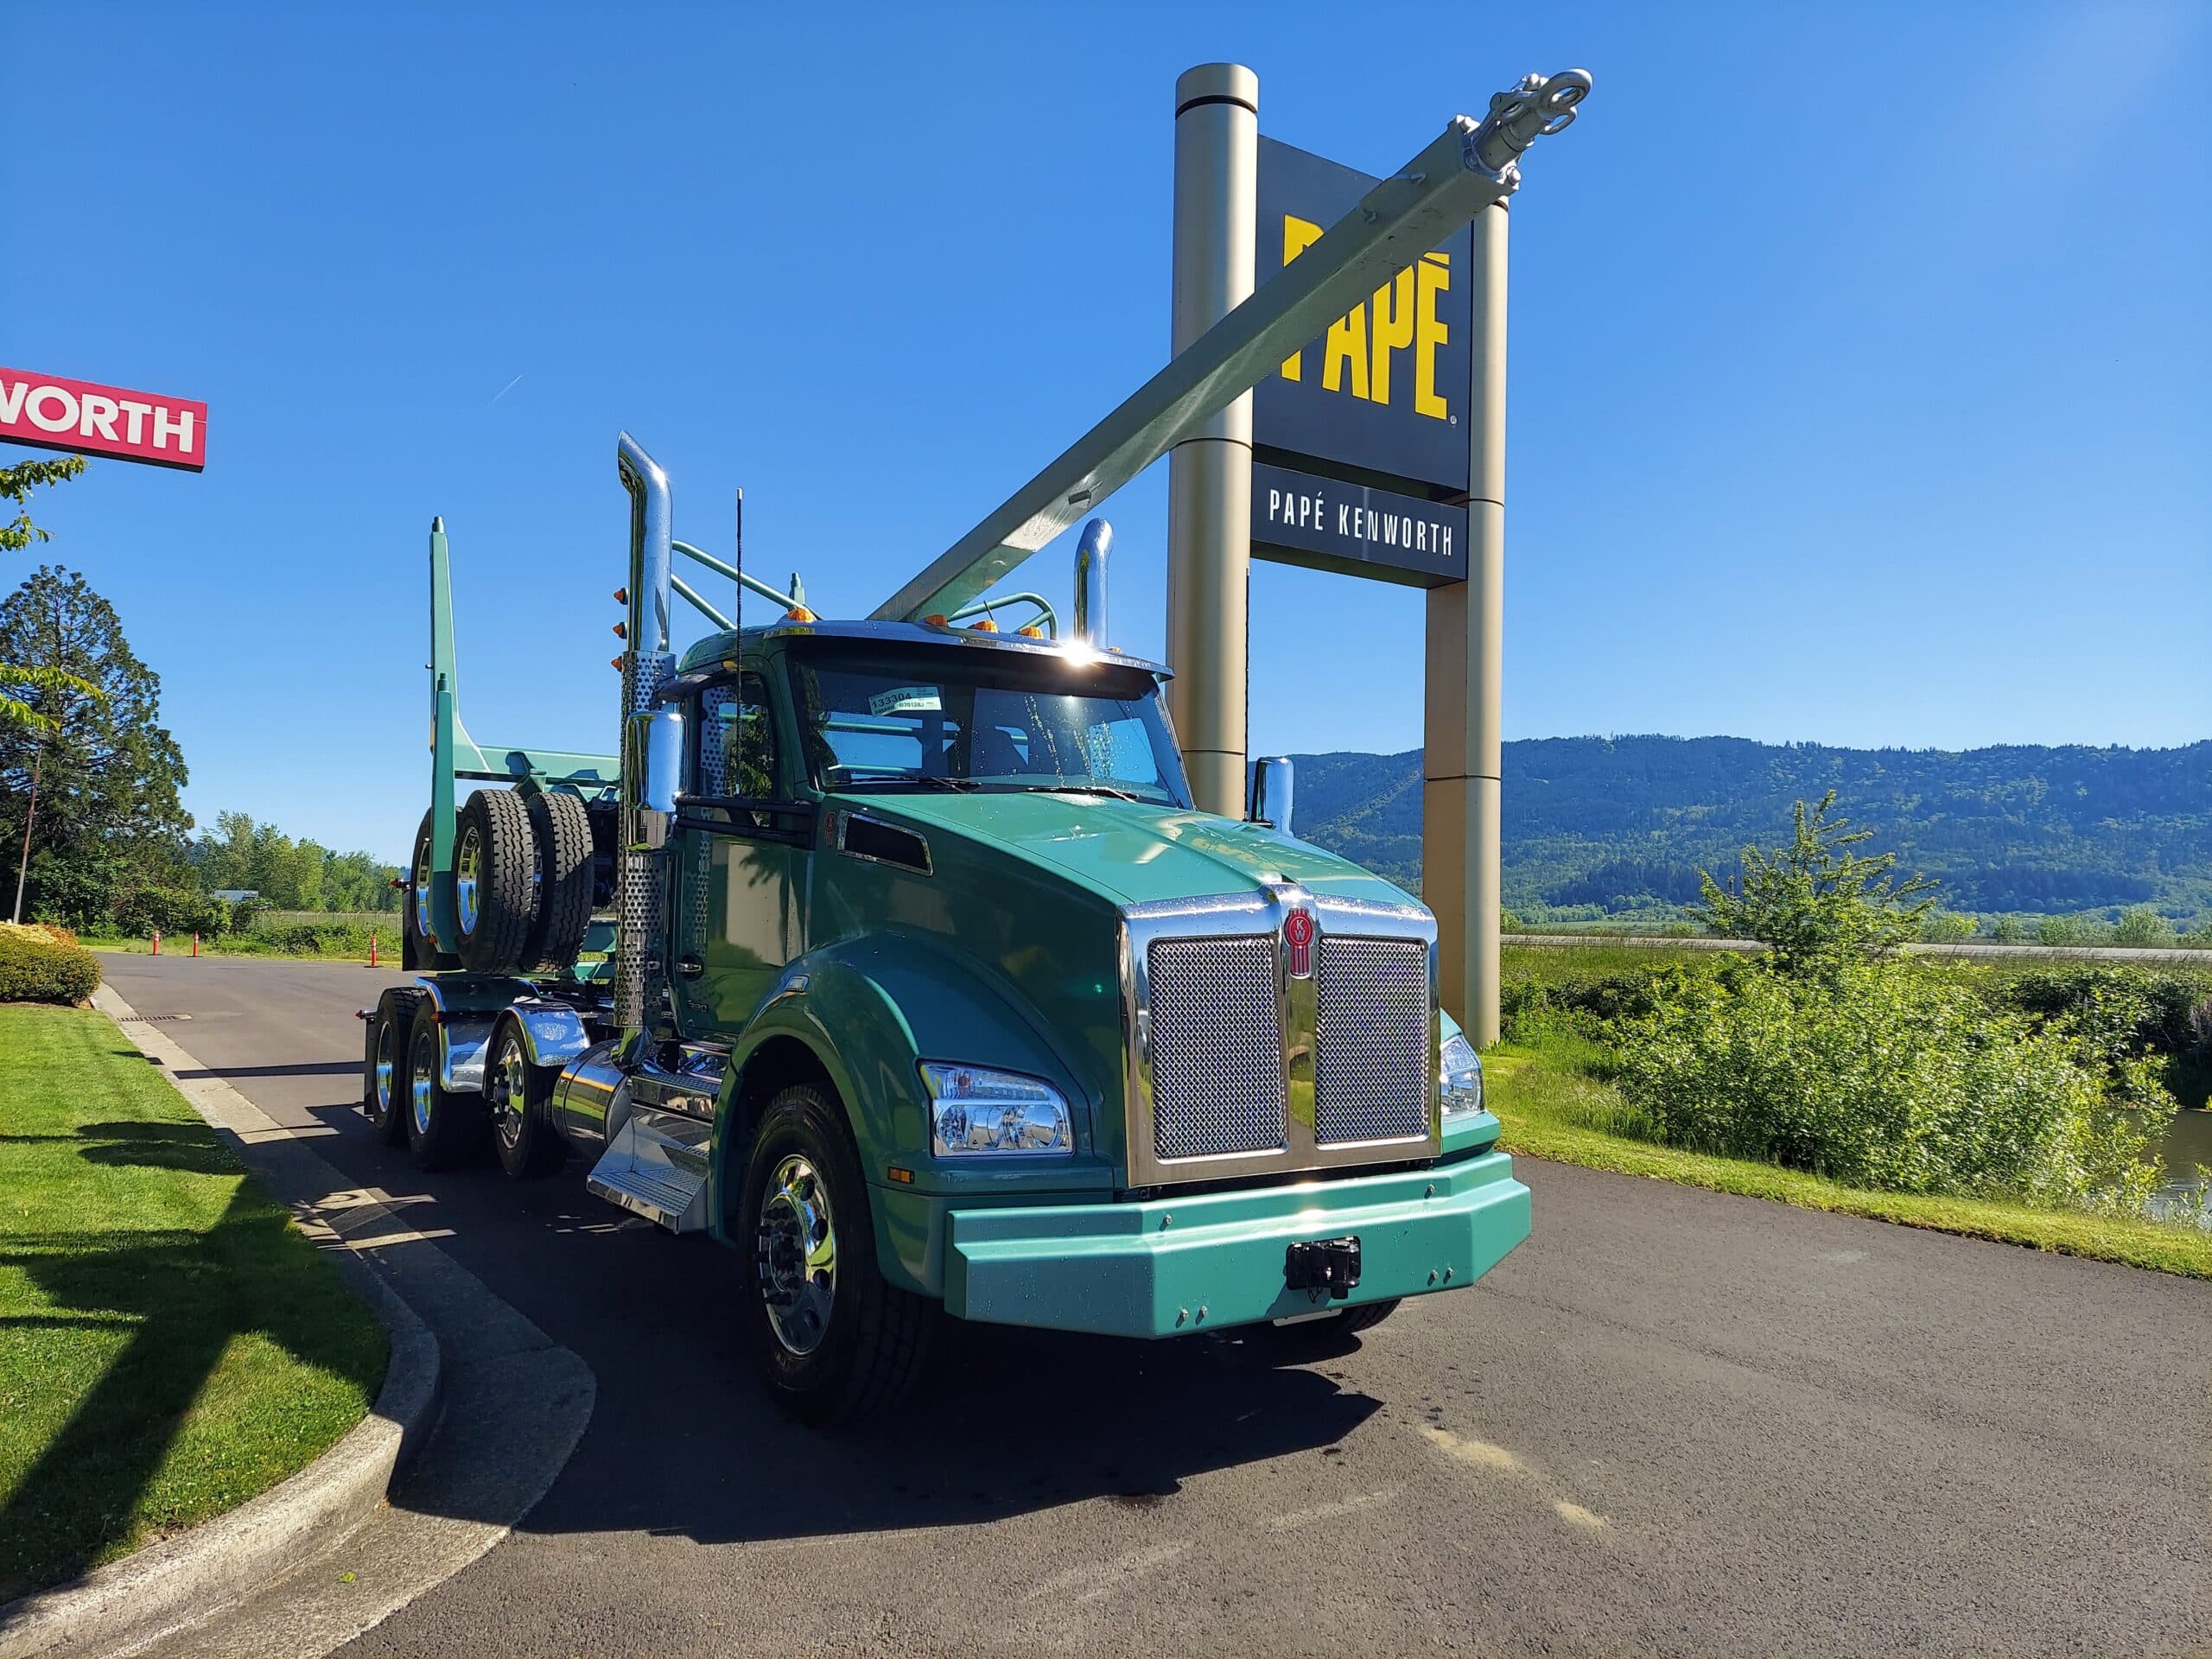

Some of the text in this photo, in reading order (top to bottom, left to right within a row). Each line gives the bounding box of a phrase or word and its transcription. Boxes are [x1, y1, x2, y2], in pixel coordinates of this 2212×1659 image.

[1269, 488, 1452, 556] PAPÉ KENWORTH
[871, 692, 912, 709] 133304
